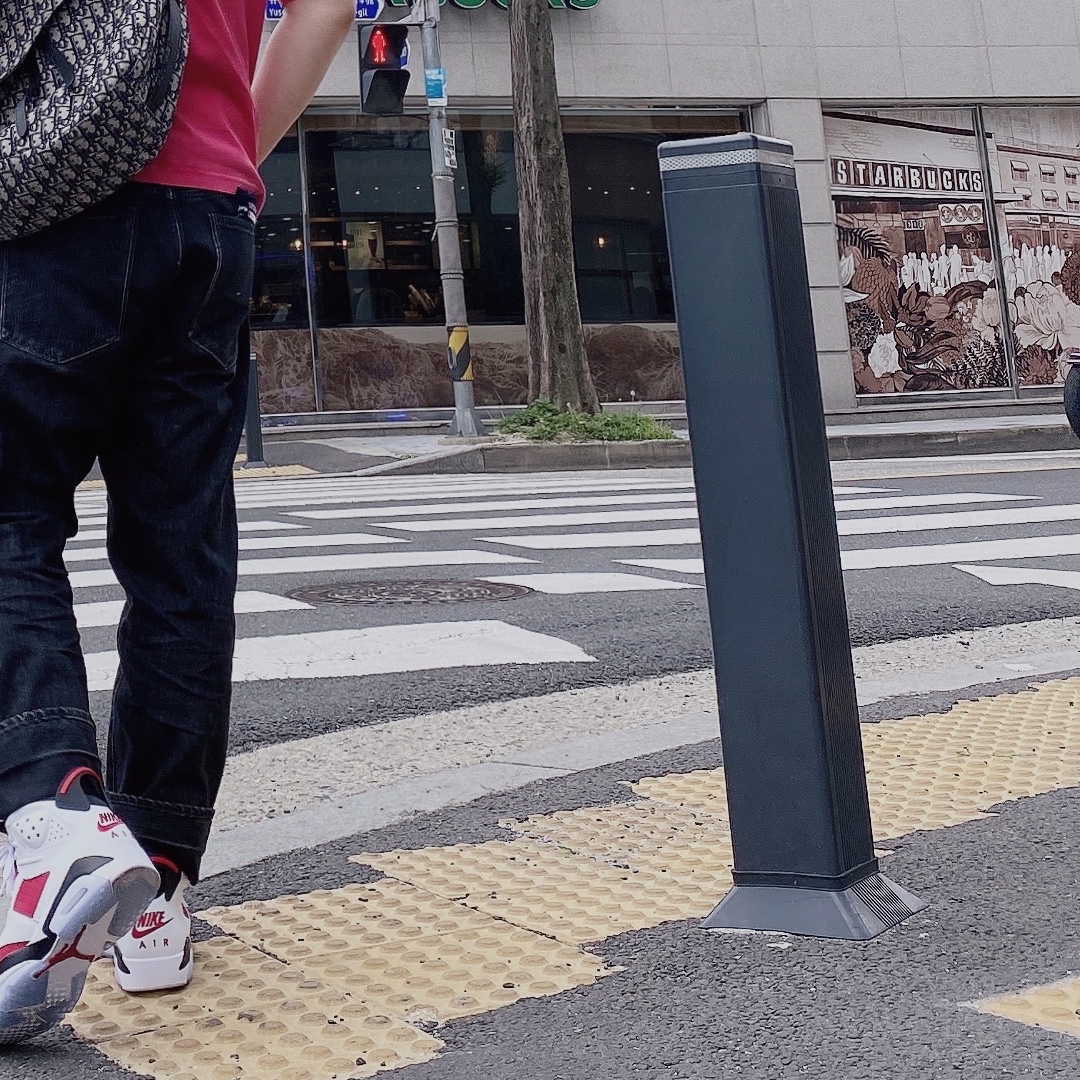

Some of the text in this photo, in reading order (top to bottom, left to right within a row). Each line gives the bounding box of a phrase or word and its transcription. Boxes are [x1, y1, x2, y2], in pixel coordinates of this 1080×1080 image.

[836, 160, 984, 193] STARBUCKS
[99, 812, 123, 824] NIK
[136, 910, 166, 928] NIKE
[139, 938, 169, 950] AIR
